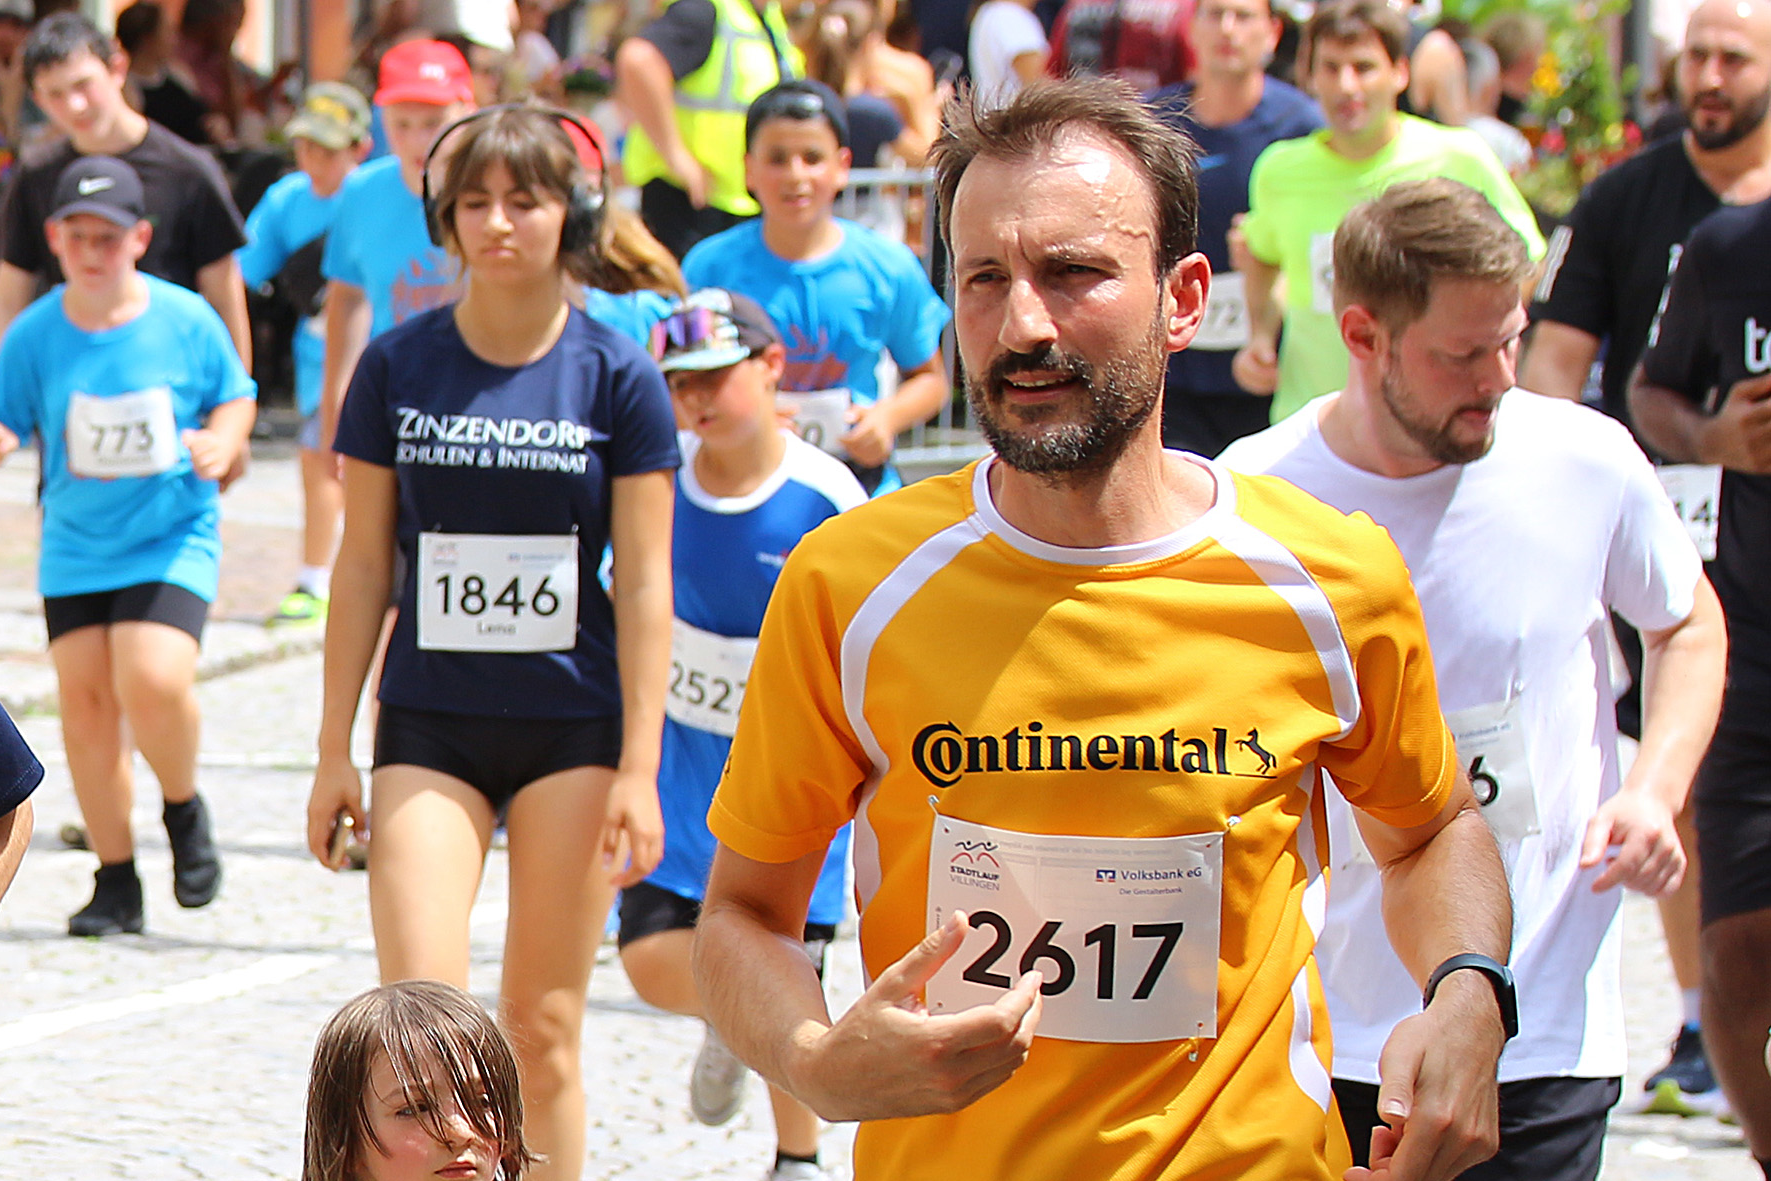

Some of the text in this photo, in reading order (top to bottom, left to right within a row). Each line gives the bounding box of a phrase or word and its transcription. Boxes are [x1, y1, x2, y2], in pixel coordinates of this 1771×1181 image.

[89, 420, 154, 453] 773
[396, 406, 592, 450] ZINZENDORF
[396, 441, 589, 474] SCHULEN & INTERNAT
[436, 573, 559, 617] 1846
[670, 660, 747, 714] 252
[911, 720, 1233, 788] Continental
[949, 865, 1001, 882] STADTLAUF
[949, 873, 1001, 892] VILLINGEN
[1120, 866, 1203, 881] Volksbank eG
[962, 910, 1184, 1000] 2617
